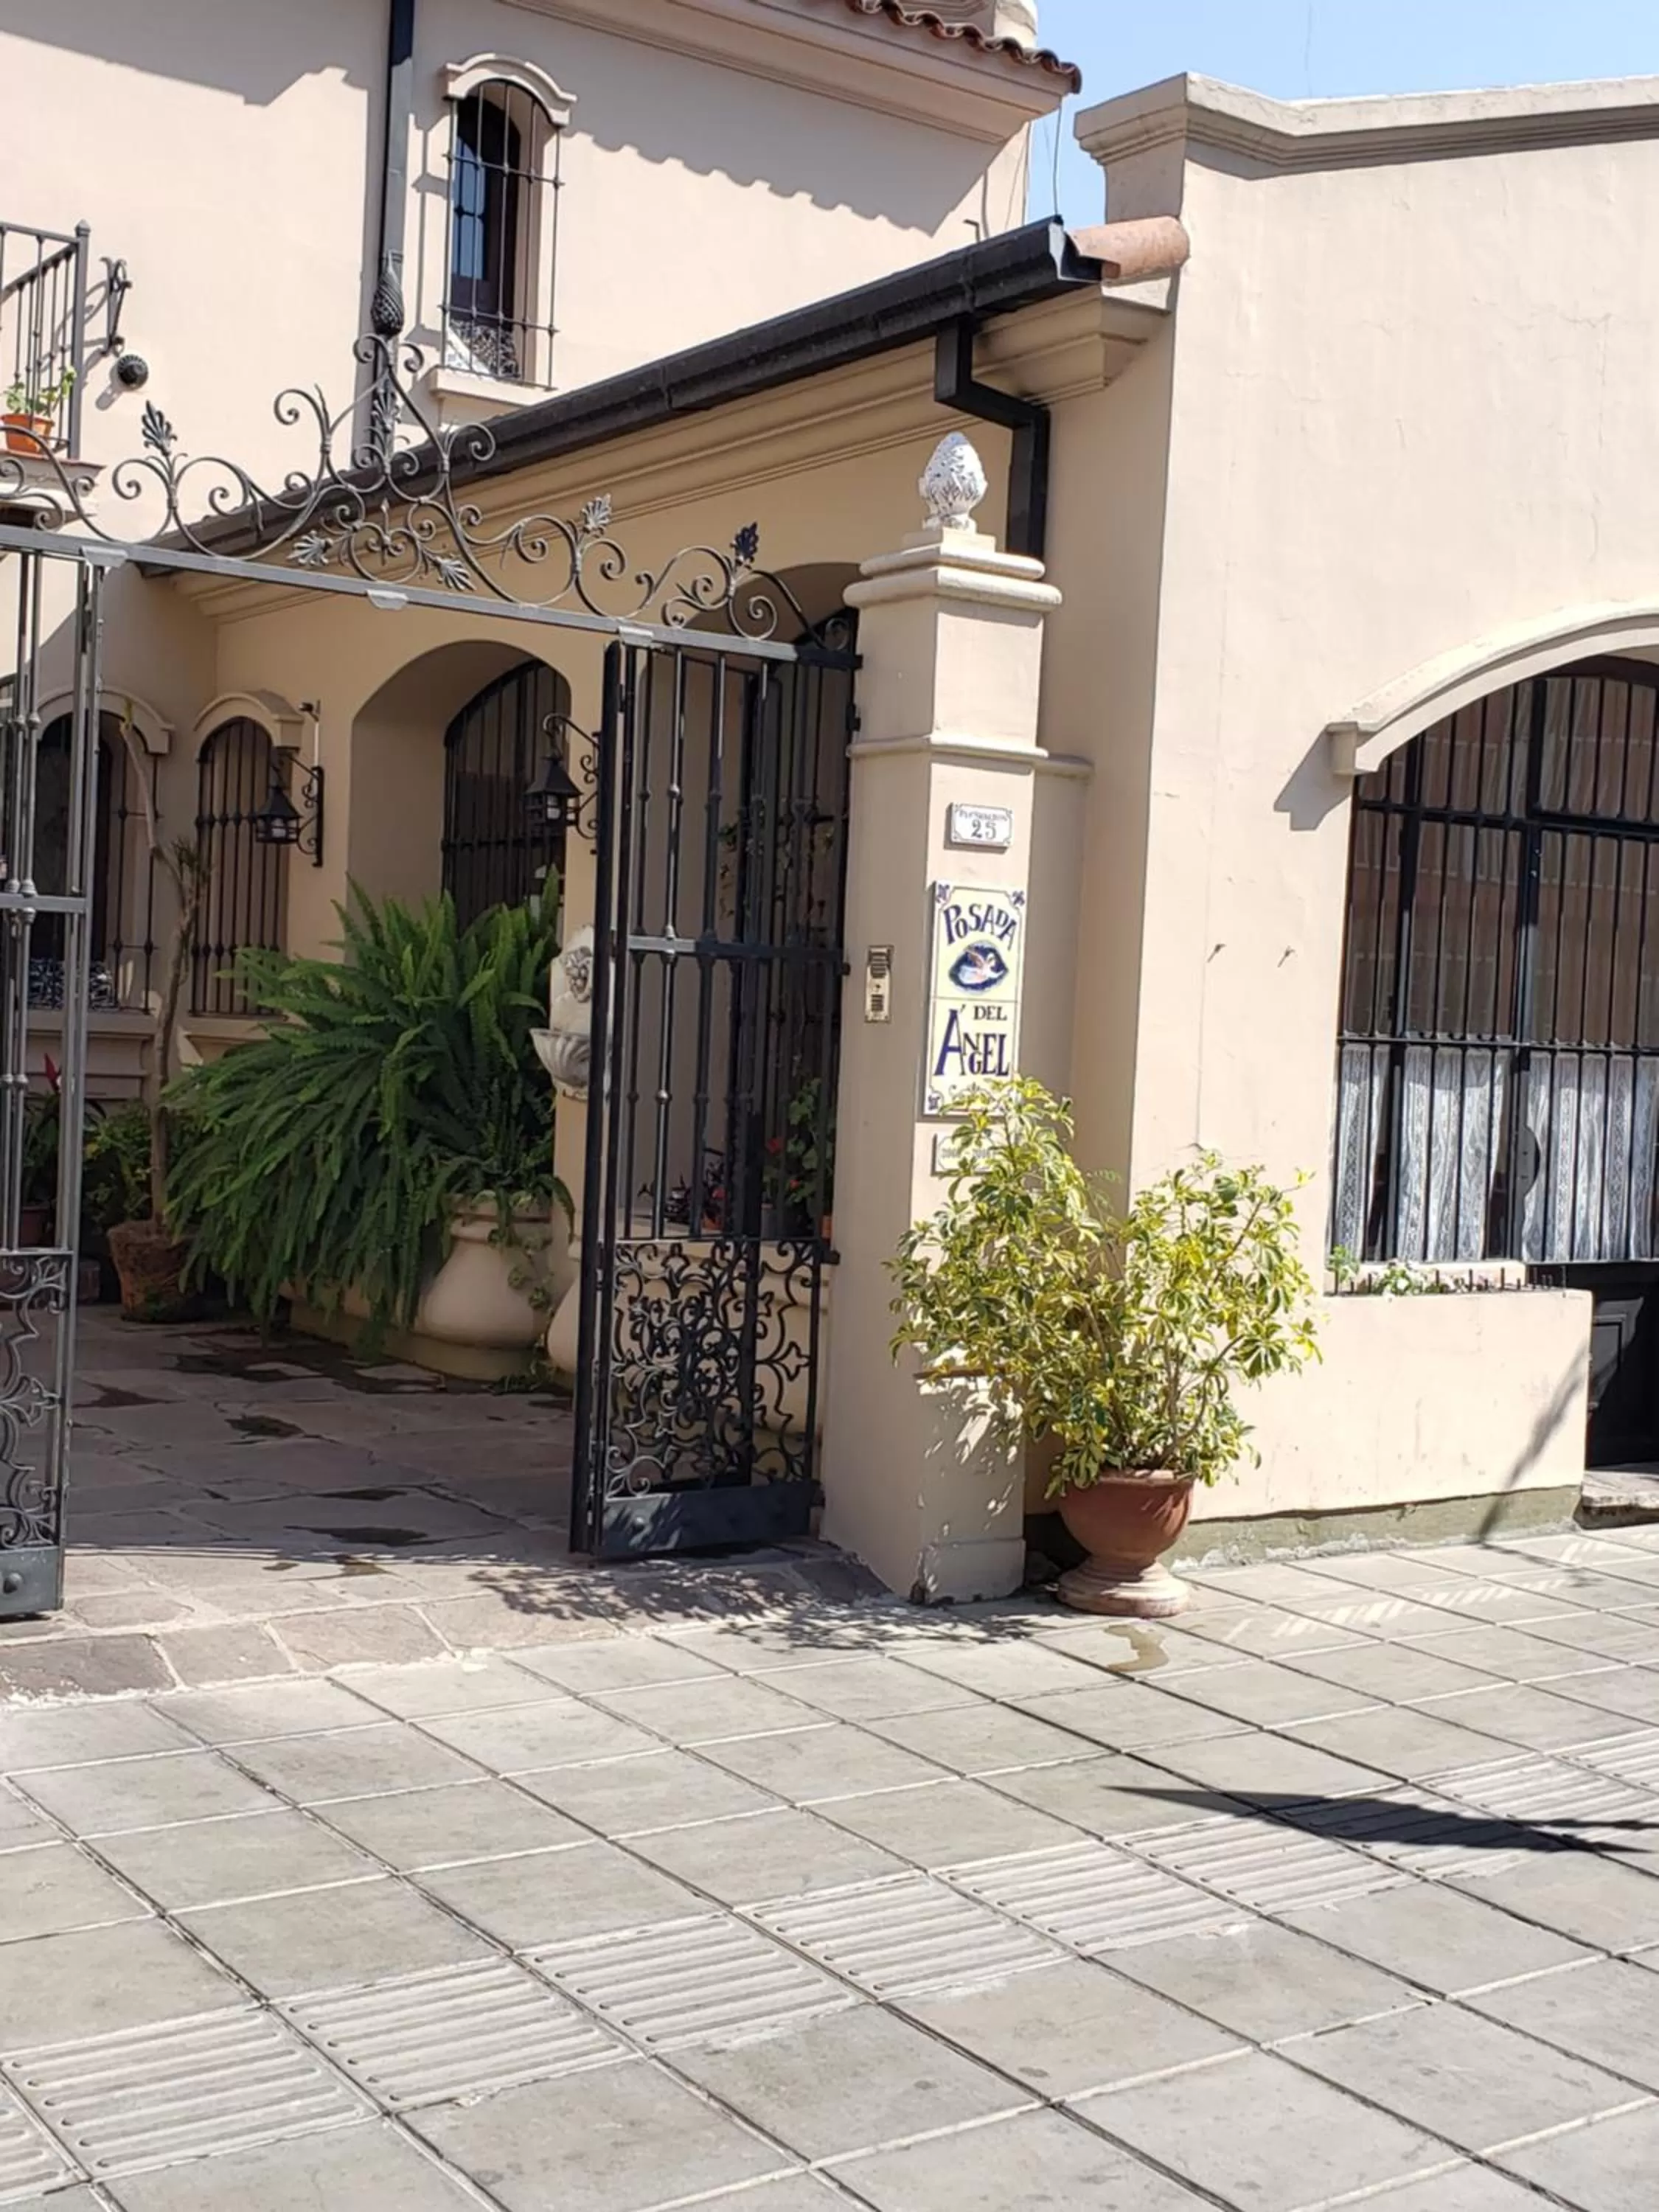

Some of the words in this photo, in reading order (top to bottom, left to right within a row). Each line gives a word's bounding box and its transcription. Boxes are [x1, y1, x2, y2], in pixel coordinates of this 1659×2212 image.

[970, 819, 997, 839] 25
[943, 902, 1018, 951] POSADA
[973, 1004, 1007, 1021] DEL
